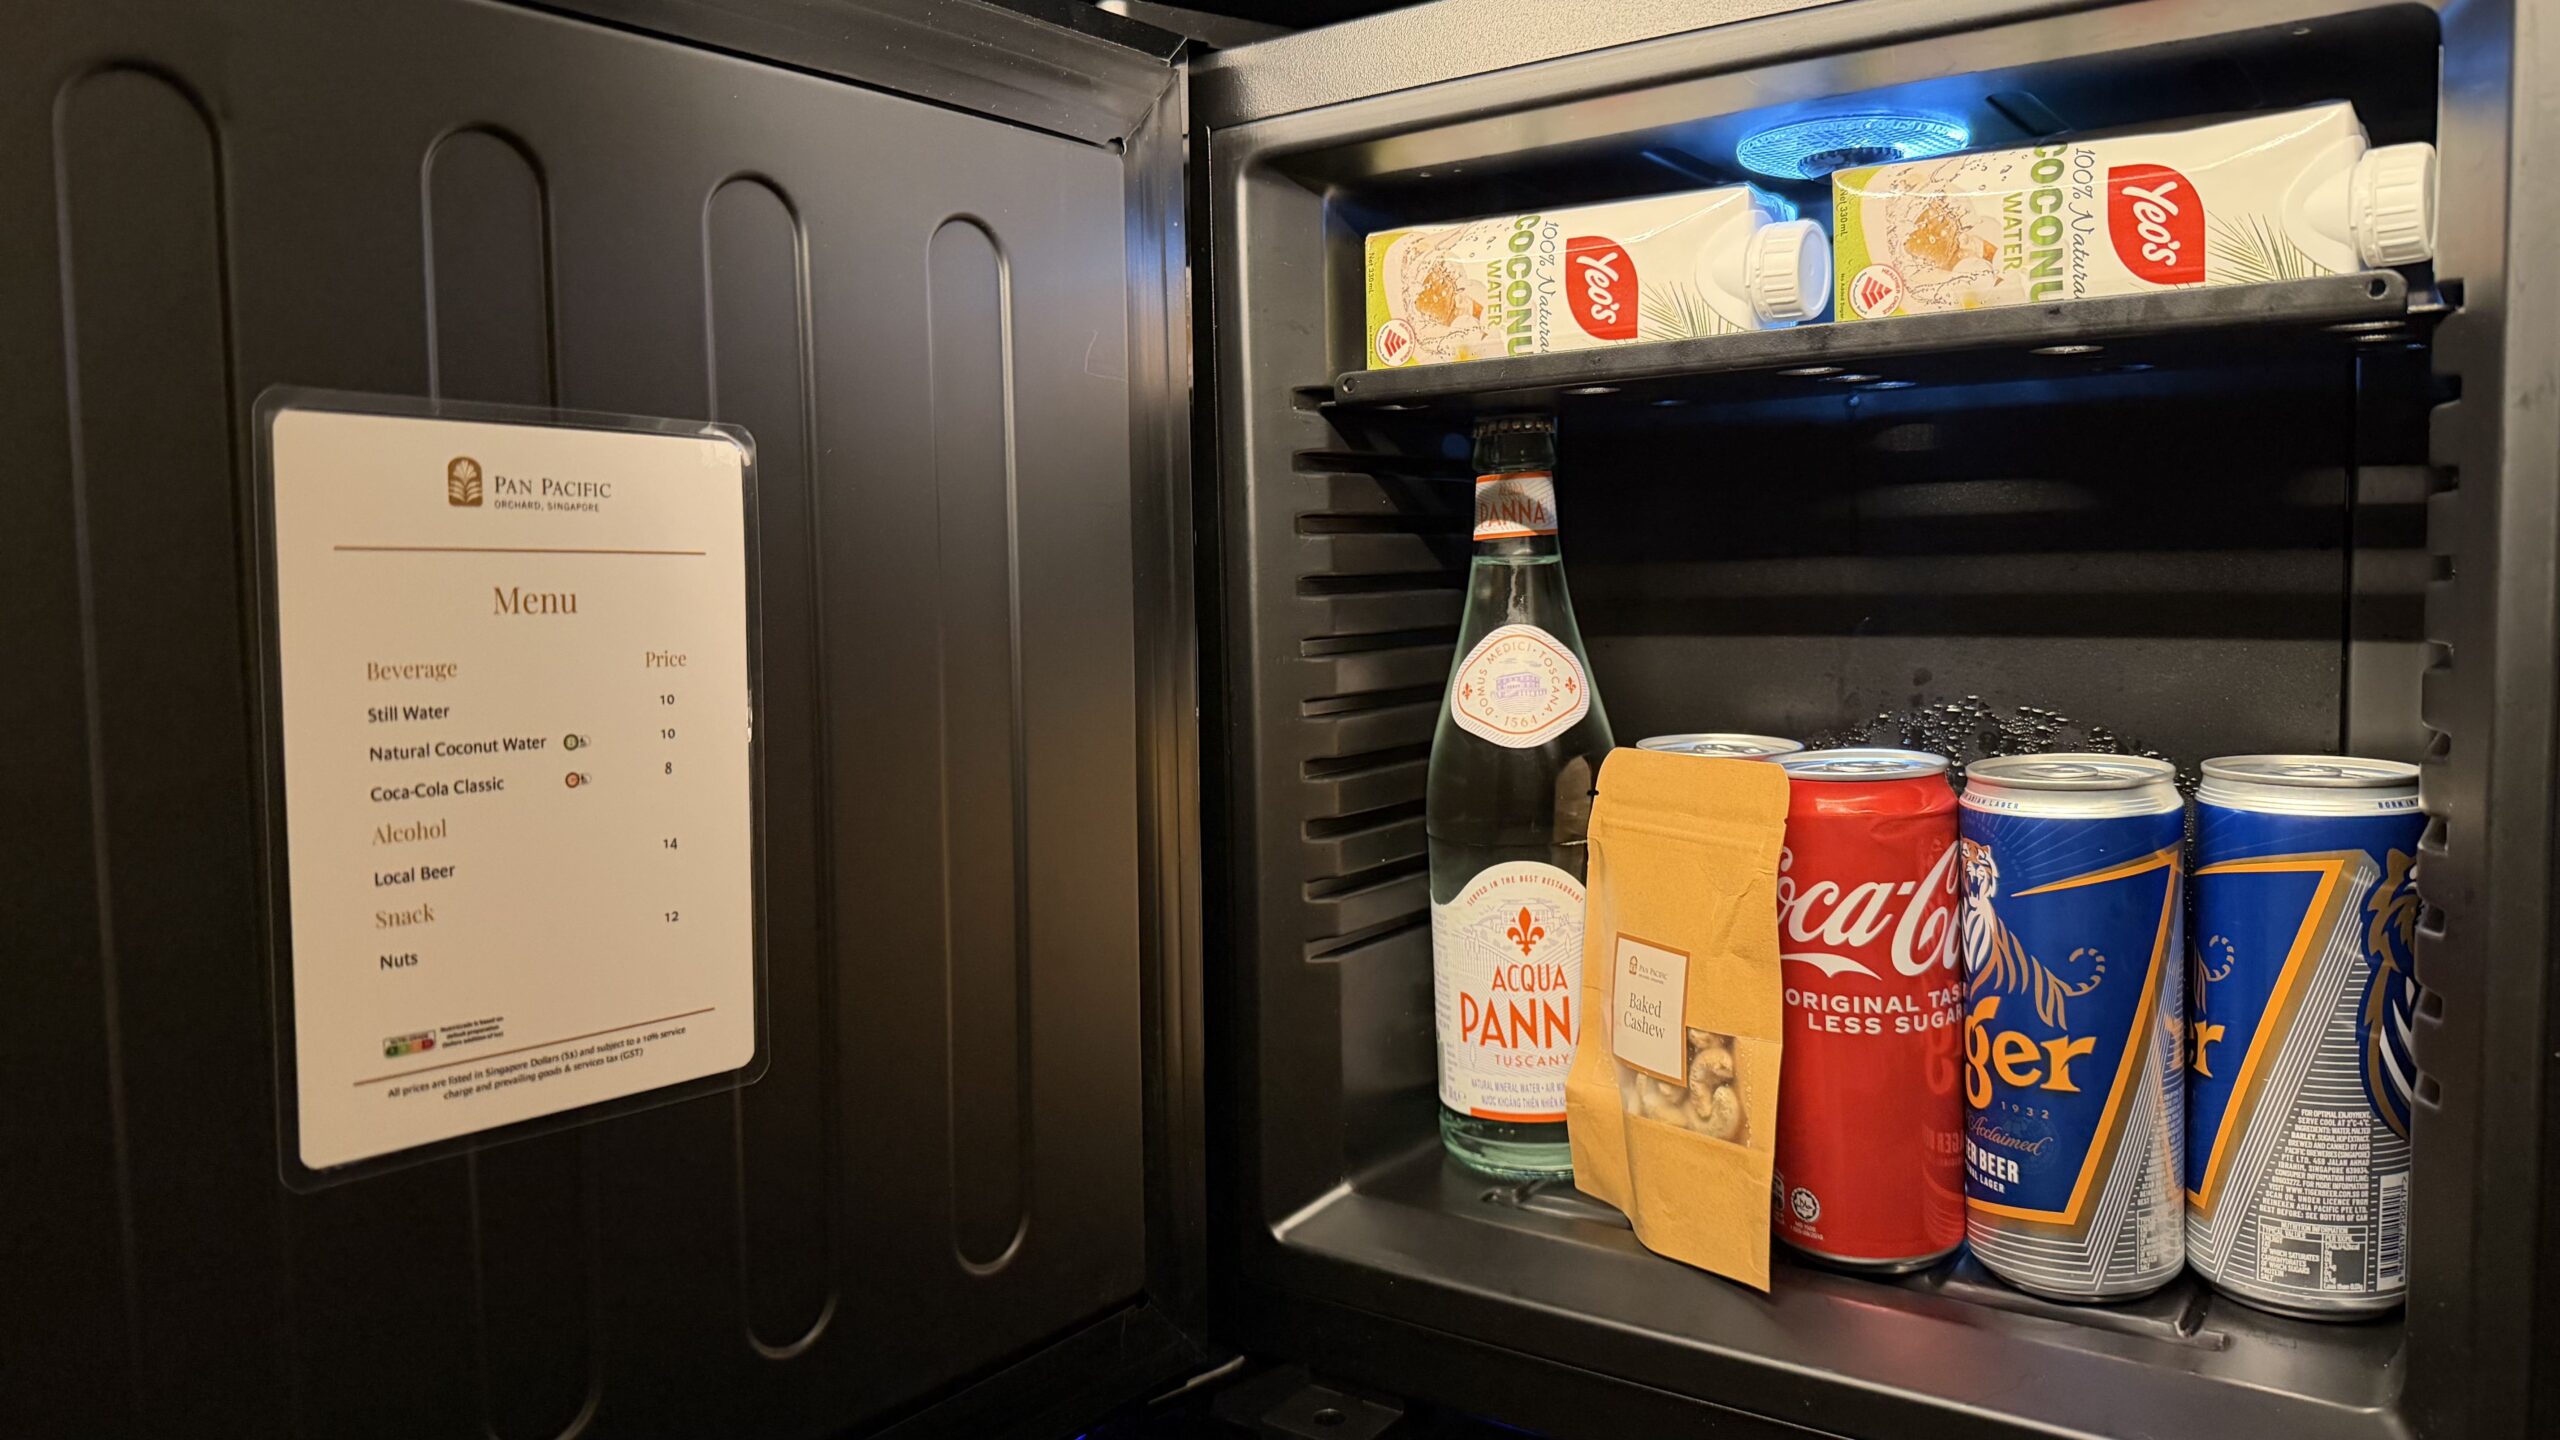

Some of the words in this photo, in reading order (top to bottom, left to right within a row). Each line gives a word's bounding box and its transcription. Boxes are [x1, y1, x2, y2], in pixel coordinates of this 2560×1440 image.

[2072, 148, 2096, 200] 100%
[2003, 192, 2024, 271] WATER
[2122, 181, 2181, 266] Yeo's
[1540, 221, 1559, 266] 100%
[1487, 260, 1503, 328] WATER
[1576, 252, 1620, 324] Yeo's
[495, 476, 532, 495] PAN
[542, 478, 611, 498] PACIFIC
[494, 500, 544, 511] ORCHARD,
[548, 502, 600, 512] SINGAPORE
[1480, 498, 1545, 528] PANNA
[494, 586, 577, 615] Menu
[646, 651, 687, 668] Price
[1487, 642, 1531, 664] MEDICI
[367, 662, 458, 681] Beverage
[1540, 651, 1560, 713] TOSCANA
[660, 694, 675, 705] 10
[1477, 668, 1494, 716] DOMUS
[368, 706, 398, 723] Still
[403, 706, 450, 721] Water
[1504, 715, 1538, 727] 1564
[662, 729, 676, 739] 10
[370, 743, 430, 762] Natural
[435, 740, 498, 756] Coconut
[503, 737, 546, 752] Water
[665, 762, 672, 775] 8
[371, 781, 448, 802] Coca-Cola
[454, 777, 504, 794] Classic
[373, 818, 446, 846] Alcohol
[664, 838, 678, 849] 14
[375, 867, 415, 887] Local
[421, 865, 456, 881] Beer
[1467, 886, 1488, 906] SERVED
[1490, 880, 1498, 889] IN
[1501, 876, 1515, 885] THE
[376, 903, 434, 929] Snack
[665, 911, 679, 922] 12
[380, 953, 418, 970] Nuts
[1492, 963, 1568, 993] ACQUA
[1629, 992, 1662, 1018] Baked
[1785, 988, 1921, 1014] ORIGINAL
[1928, 984, 1961, 1008] TAS
[1460, 992, 1580, 1049] PANN
[1624, 1011, 1666, 1039] Cashew
[1808, 1013, 1882, 1034] LESS
[1895, 1004, 1962, 1034] SUGAR
[388, 1088, 400, 1098] All
[403, 1083, 429, 1097] prices
[432, 1080, 447, 1089] are
[448, 1073, 472, 1086] listed
[486, 1062, 527, 1077] Singapore
[530, 1054, 559, 1068] Dollars
[580, 1046, 595, 1057] and
[597, 1040, 625, 1053] subject
[626, 1038, 634, 1046] to
[643, 1033, 659, 1042] 10%
[660, 1027, 686, 1039] service
[1495, 1054, 1569, 1068] TUSCANY
[443, 1087, 474, 1100] charge
[476, 1081, 492, 1093] and
[494, 1073, 536, 1090] prevailing
[538, 1067, 562, 1081] goods
[565, 1064, 571, 1073] &
[573, 1057, 604, 1070] services
[606, 1055, 618, 1063] tax
[620, 1048, 644, 1062] (GST)
[1471, 1079, 1494, 1091] NATURAL
[1494, 1082, 1519, 1093] MINERAL
[1520, 1083, 1541, 1094] WATER
[2001, 1101, 2049, 1120] 1932
[2301, 1109, 2313, 1117] FOR
[2314, 1110, 2337, 1118] OPTIMAL
[2298, 1117, 2319, 1125] SERVE
[2320, 1118, 2336, 1126] COOL
[2352, 1127, 2371, 1135] MALTED
[1968, 1117, 2054, 1156] Acclaimed
[2288, 1139, 2313, 1148] BREWED
[2327, 1142, 2349, 1150] CANNED
[2282, 1154, 2294, 1162] PTE
[2285, 1146, 2306, 1155] PACIFIC
[2307, 1149, 2337, 1158] BREWERIES
[1980, 1148, 2019, 1184] BEER
[2275, 1169, 2306, 1179] CONSUMER
[2307, 1173, 2344, 1182] INFORMATION
[2308, 1165, 2344, 1174] SINGAPORE
[1980, 1173, 2005, 1194] LAGER
[2269, 1183, 2284, 1192] VISIT
[2303, 1180, 2314, 1188] FOR
[2316, 1181, 2331, 1189] MORE
[2333, 1182, 2369, 1190] INFORMATION
[2263, 1197, 2294, 1209] HEINEKEN
[2296, 1203, 2312, 1212] ASIA
[2314, 1205, 2339, 1213] PACIFIC
[2266, 1190, 2283, 1199] SCAN
[2298, 1196, 2320, 1204] UNDER
[2260, 1204, 2275, 1214] BEST
[2277, 1207, 2304, 1218] BEFORE:
[2305, 1212, 2318, 1220] SEE
